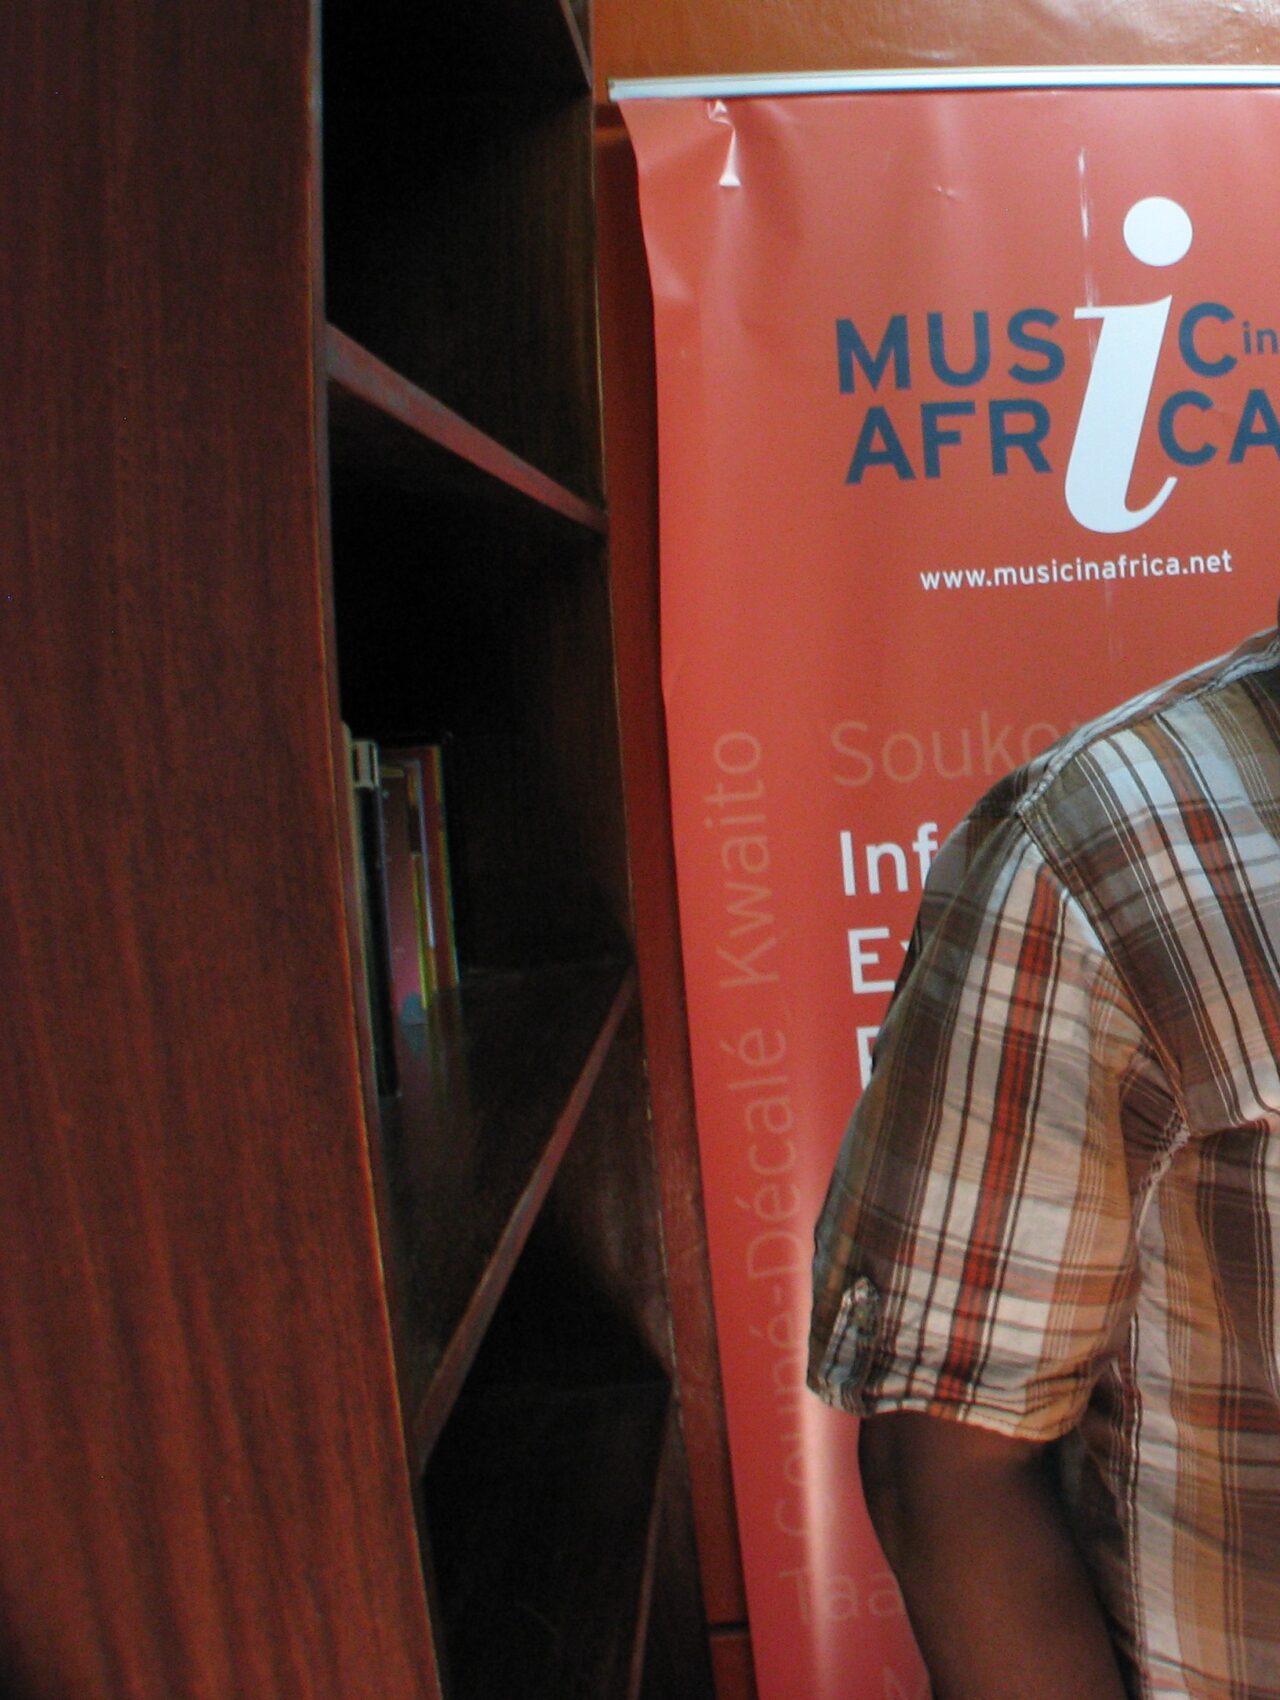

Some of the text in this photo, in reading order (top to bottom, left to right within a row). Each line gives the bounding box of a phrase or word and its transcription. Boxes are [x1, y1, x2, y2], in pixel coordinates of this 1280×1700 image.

[1242, 320, 1280, 356] in
[919, 548, 1233, 591] www.musicinafrica.net
[831, 709, 1082, 787] Souko
[703, 730, 781, 989] Kwaito
